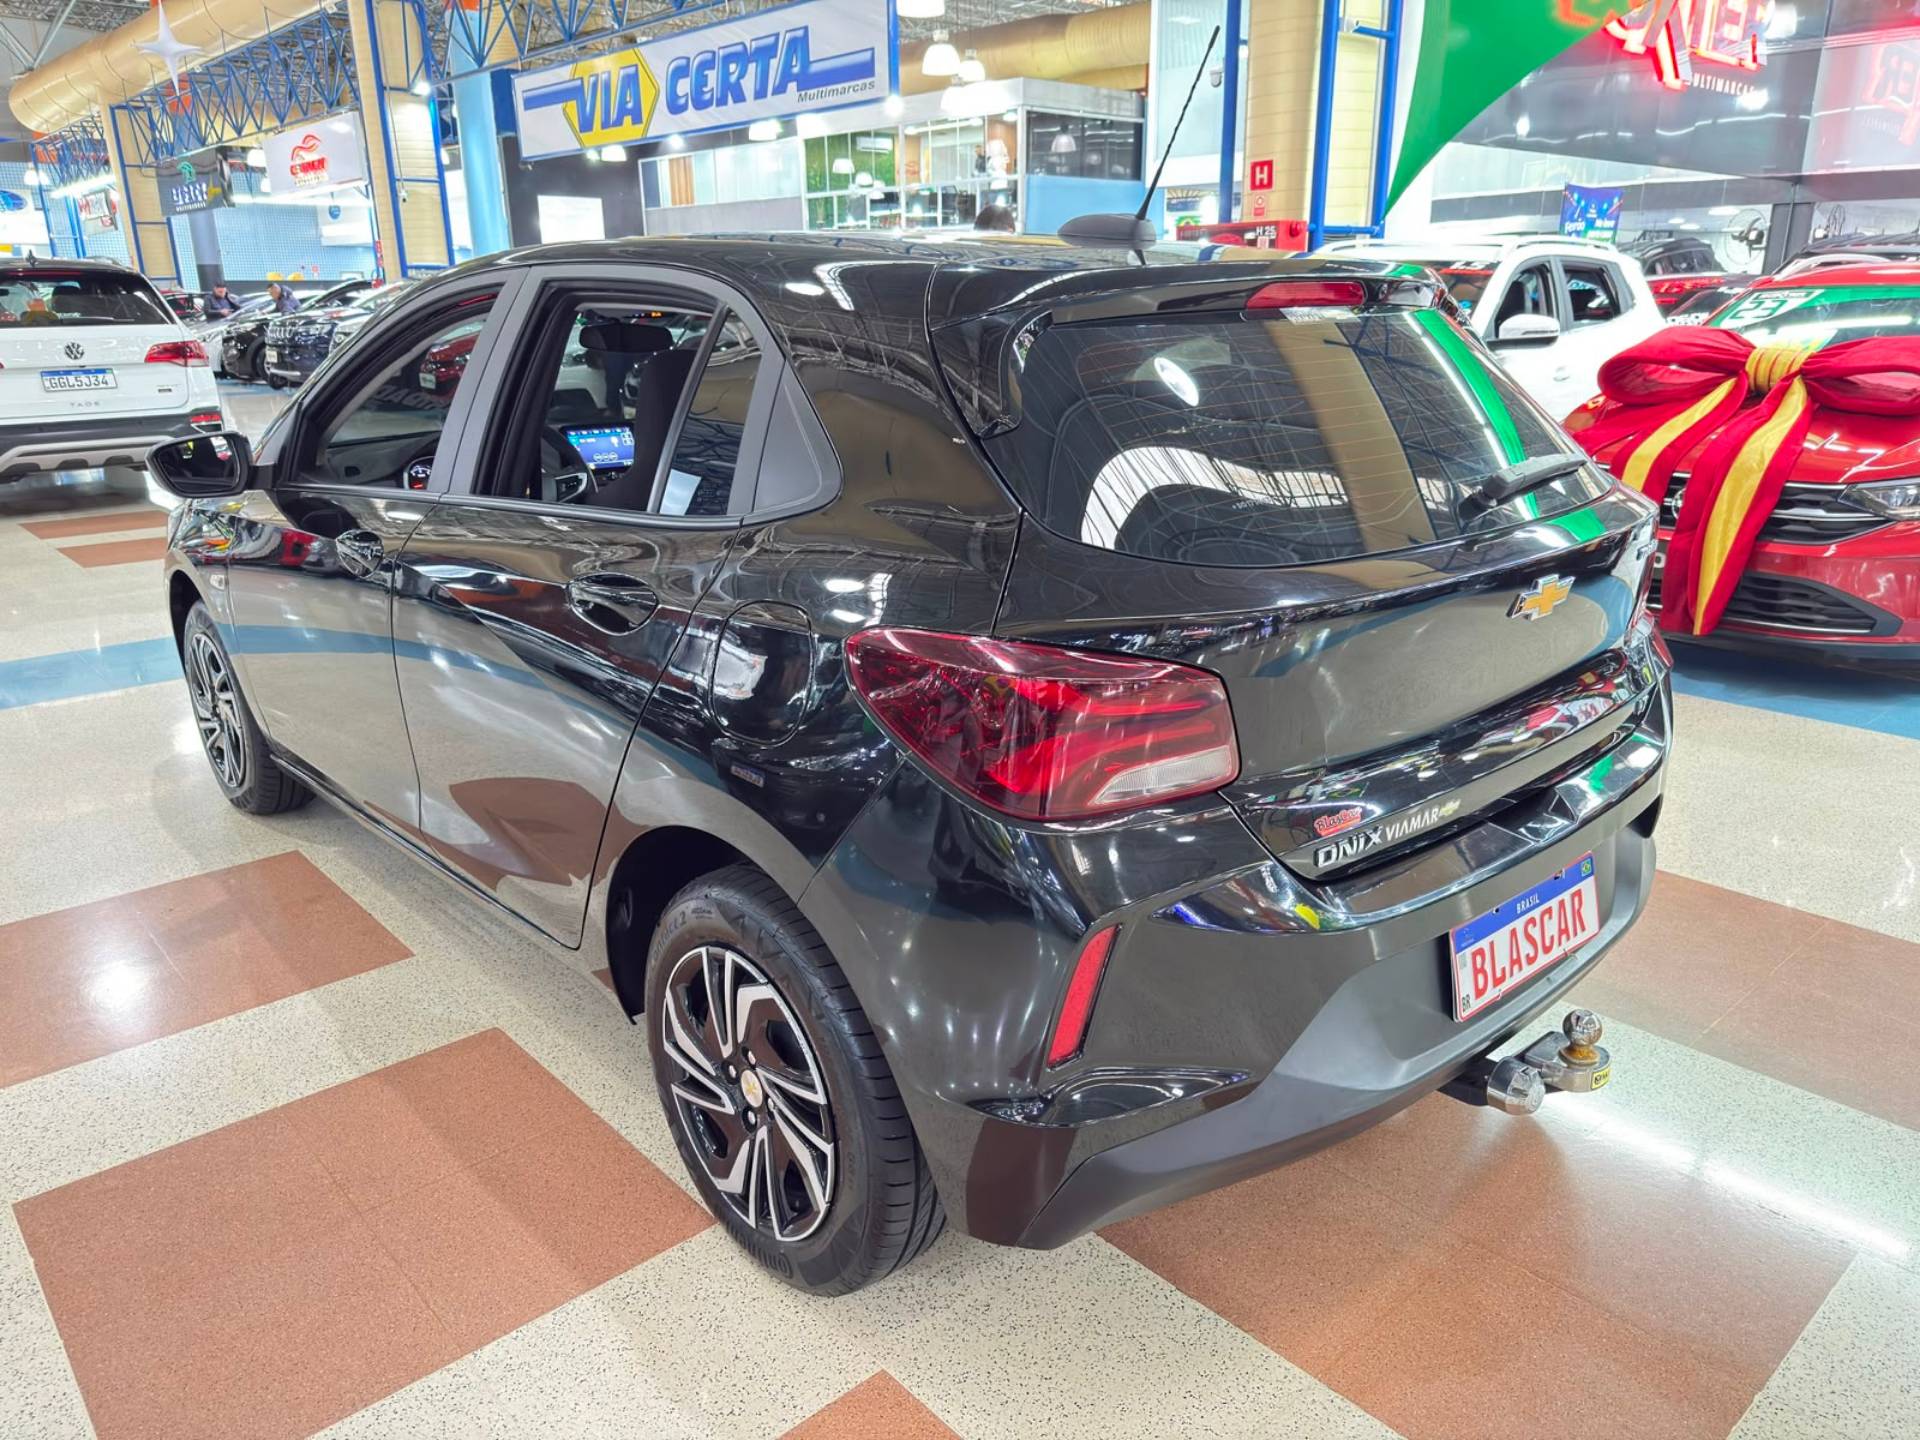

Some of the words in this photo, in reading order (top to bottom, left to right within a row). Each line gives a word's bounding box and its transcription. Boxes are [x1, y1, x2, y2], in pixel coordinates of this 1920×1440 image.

[575, 64, 643, 133] VIA
[665, 25, 811, 116] CERTA
[1690, 72, 1756, 98] ULTIMARCAS
[797, 80, 876, 103] Multimarcas
[1255, 165, 1268, 186] H
[48, 374, 109, 389] GGL5J34
[1386, 807, 1440, 842] VIAMAR
[1516, 892, 1540, 915] BRASIL
[1471, 888, 1587, 1001] BLASCAR
[1461, 994, 1471, 1013] BR
